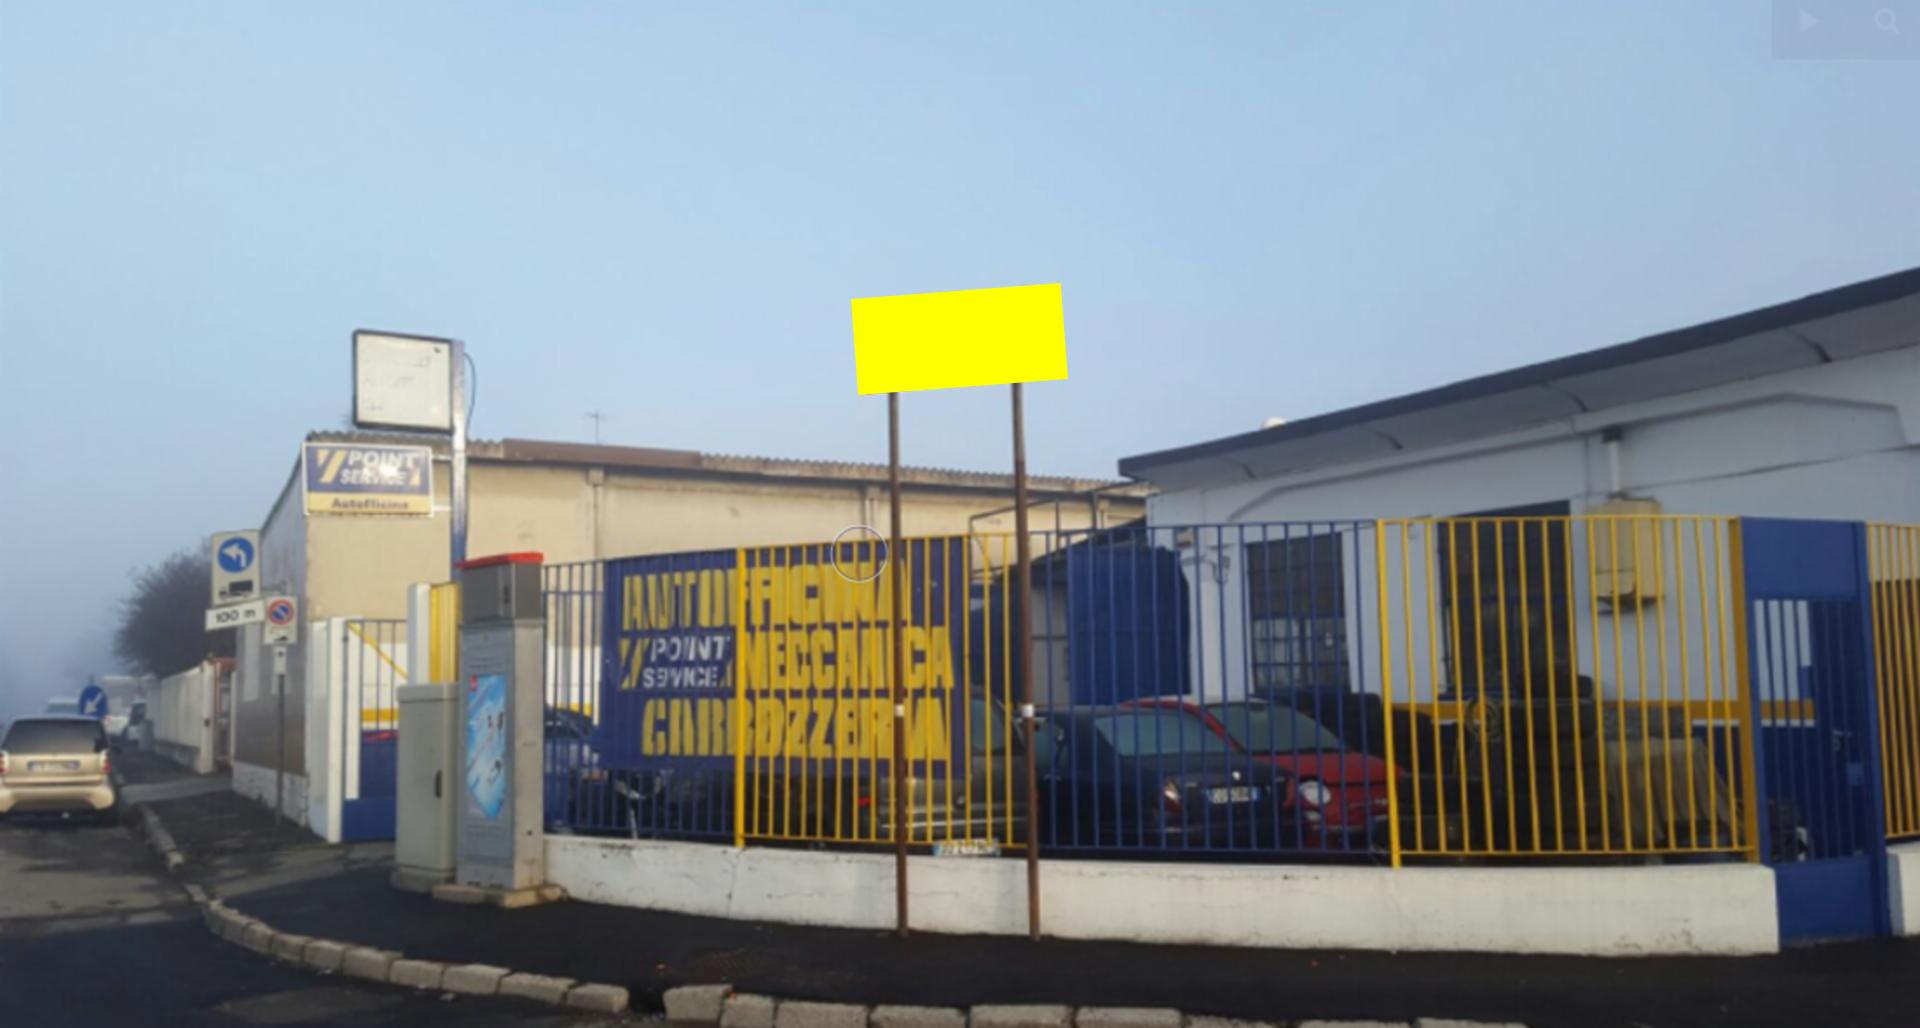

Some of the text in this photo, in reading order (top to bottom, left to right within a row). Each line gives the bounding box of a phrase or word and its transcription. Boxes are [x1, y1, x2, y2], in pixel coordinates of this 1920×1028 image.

[348, 450, 418, 468] POINT
[215, 611, 240, 624] 100
[650, 635, 725, 662] POINT
